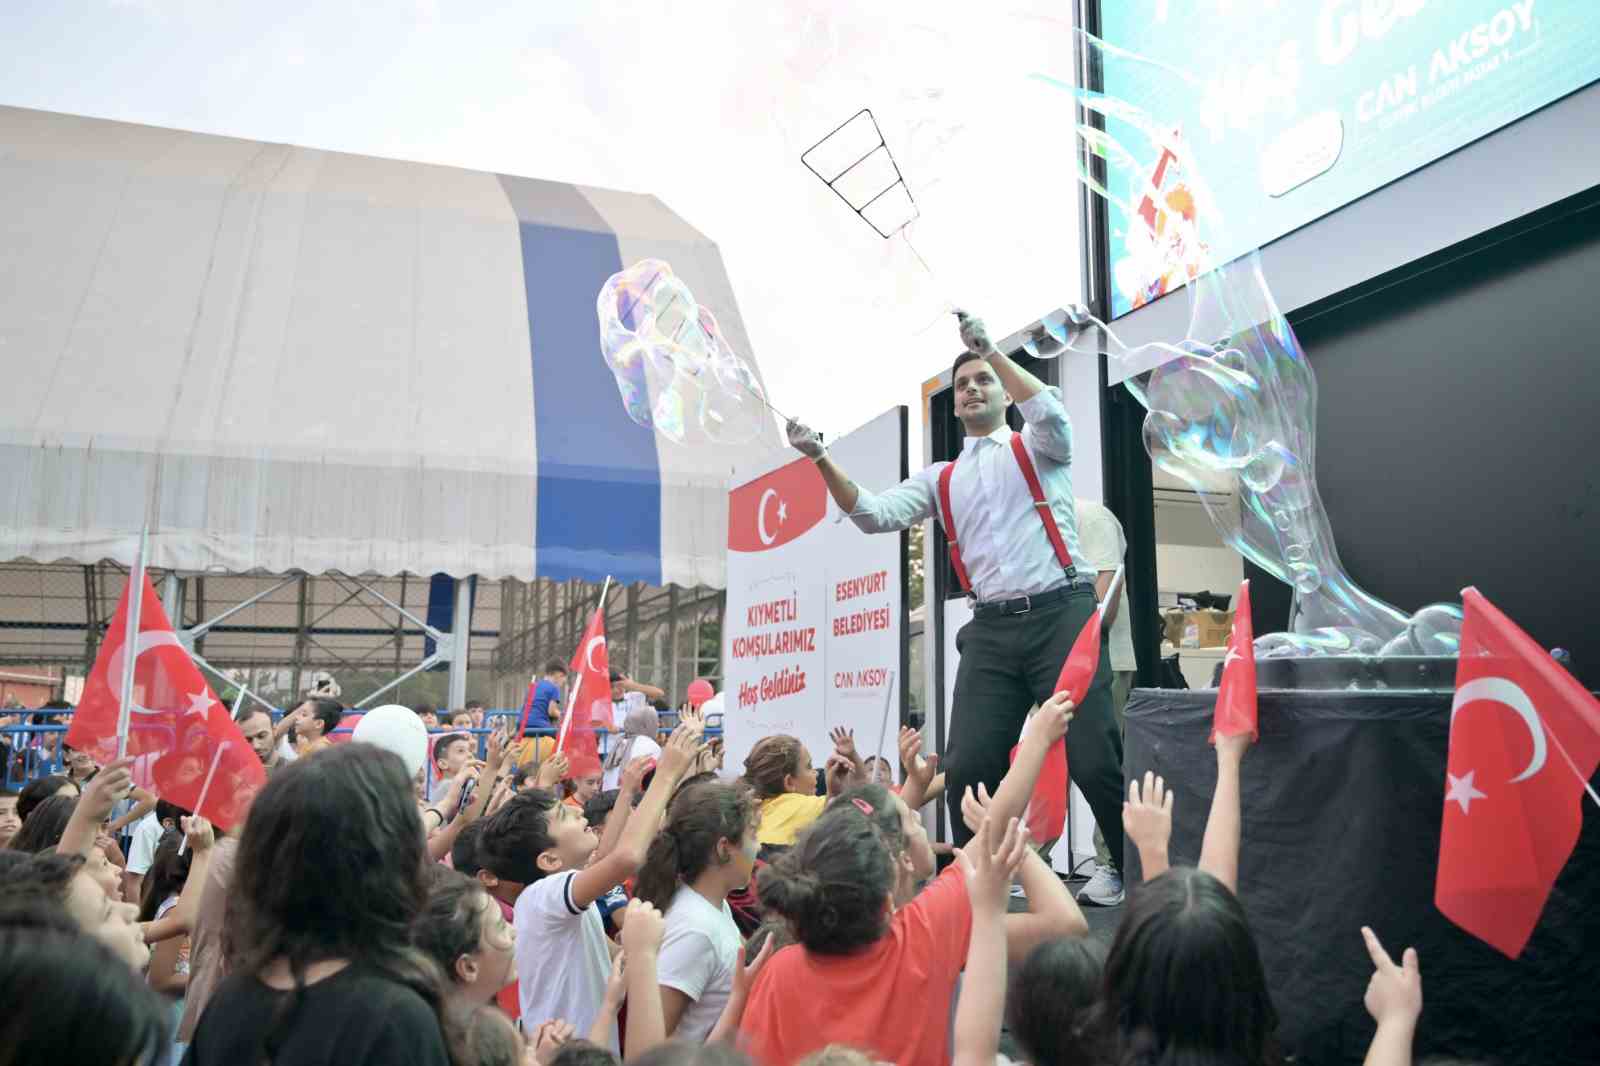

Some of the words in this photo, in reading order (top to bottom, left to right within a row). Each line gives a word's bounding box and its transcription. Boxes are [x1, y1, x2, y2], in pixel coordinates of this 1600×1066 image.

[1356, 64, 1417, 124] CAN
[1428, 0, 1536, 84] AKSOY
[836, 571, 888, 602] ESENYURT
[747, 590, 797, 628] KIYMETLİ
[833, 603, 890, 637] BELEDİYESİ
[732, 627, 816, 662] KOMŞULARIMIZ
[738, 681, 758, 712] Hoş
[760, 665, 806, 702] Geldiniz
[834, 671, 854, 689] CAN
[857, 668, 888, 688] AKSOY
